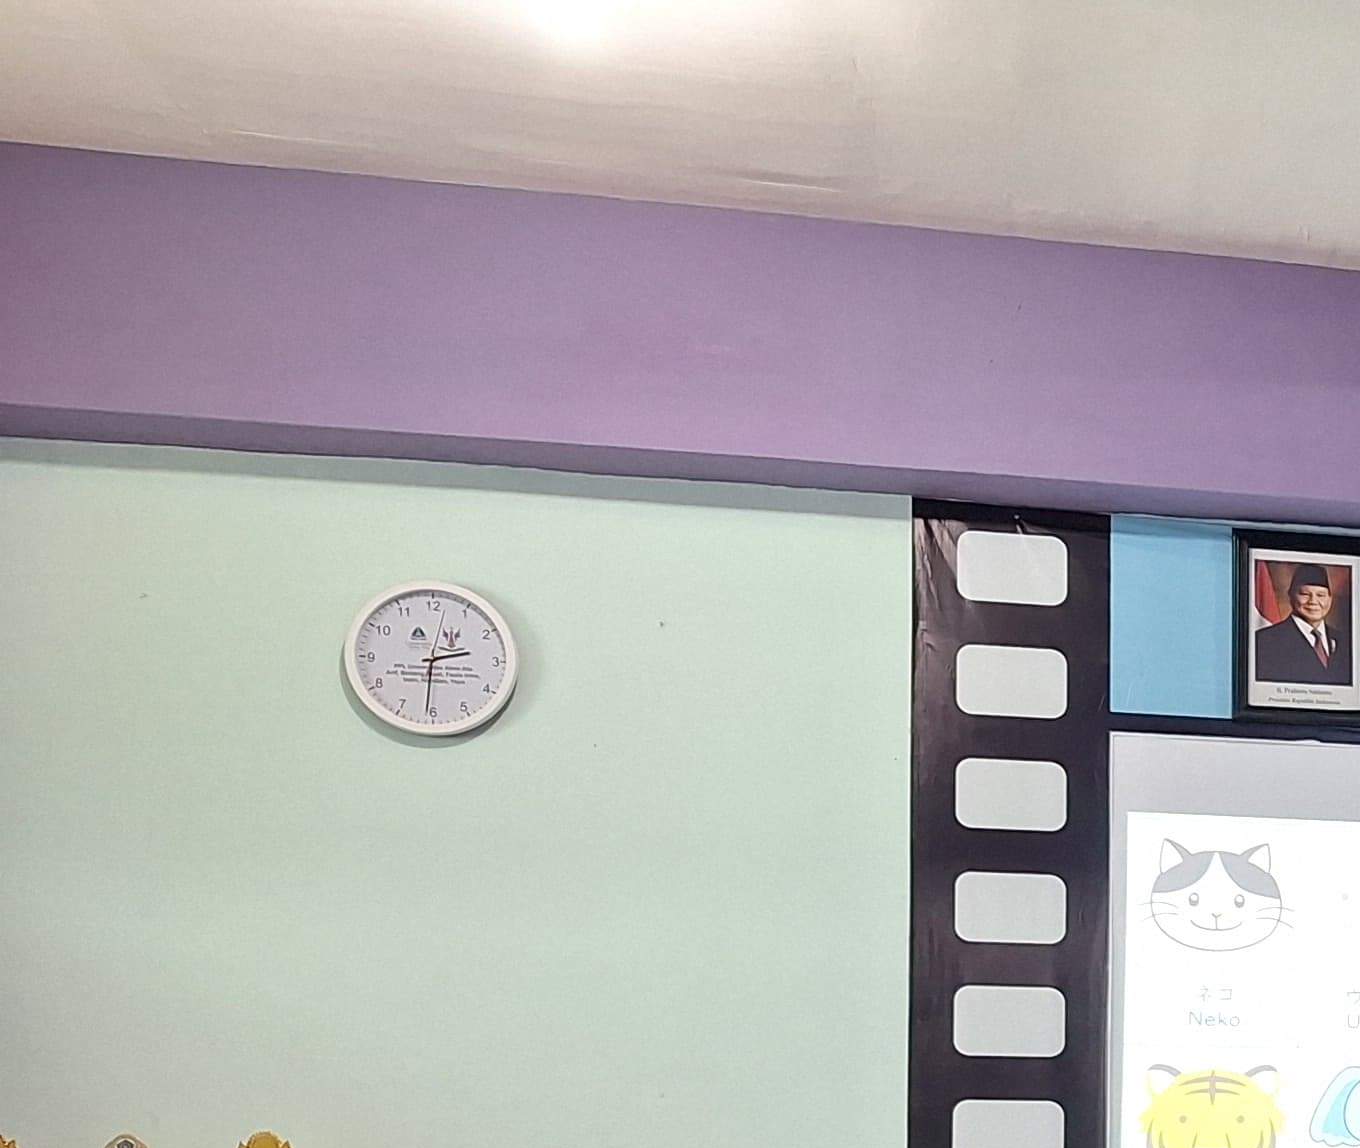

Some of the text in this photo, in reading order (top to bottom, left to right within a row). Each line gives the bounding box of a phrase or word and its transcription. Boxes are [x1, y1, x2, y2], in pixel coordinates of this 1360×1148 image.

[398, 606, 410, 617] 11
[426, 600, 440, 612] 12
[462, 609, 468, 618] 1
[376, 625, 391, 636] 10
[482, 629, 491, 640] 2
[367, 651, 375, 663] 9
[491, 656, 500, 668] 3
[375, 678, 383, 689] 8
[482, 683, 491, 694] 4
[399, 698, 407, 709] 7
[459, 701, 468, 712] 5
[429, 706, 438, 718] 6
[1188, 1011, 1241, 1027] Neko
